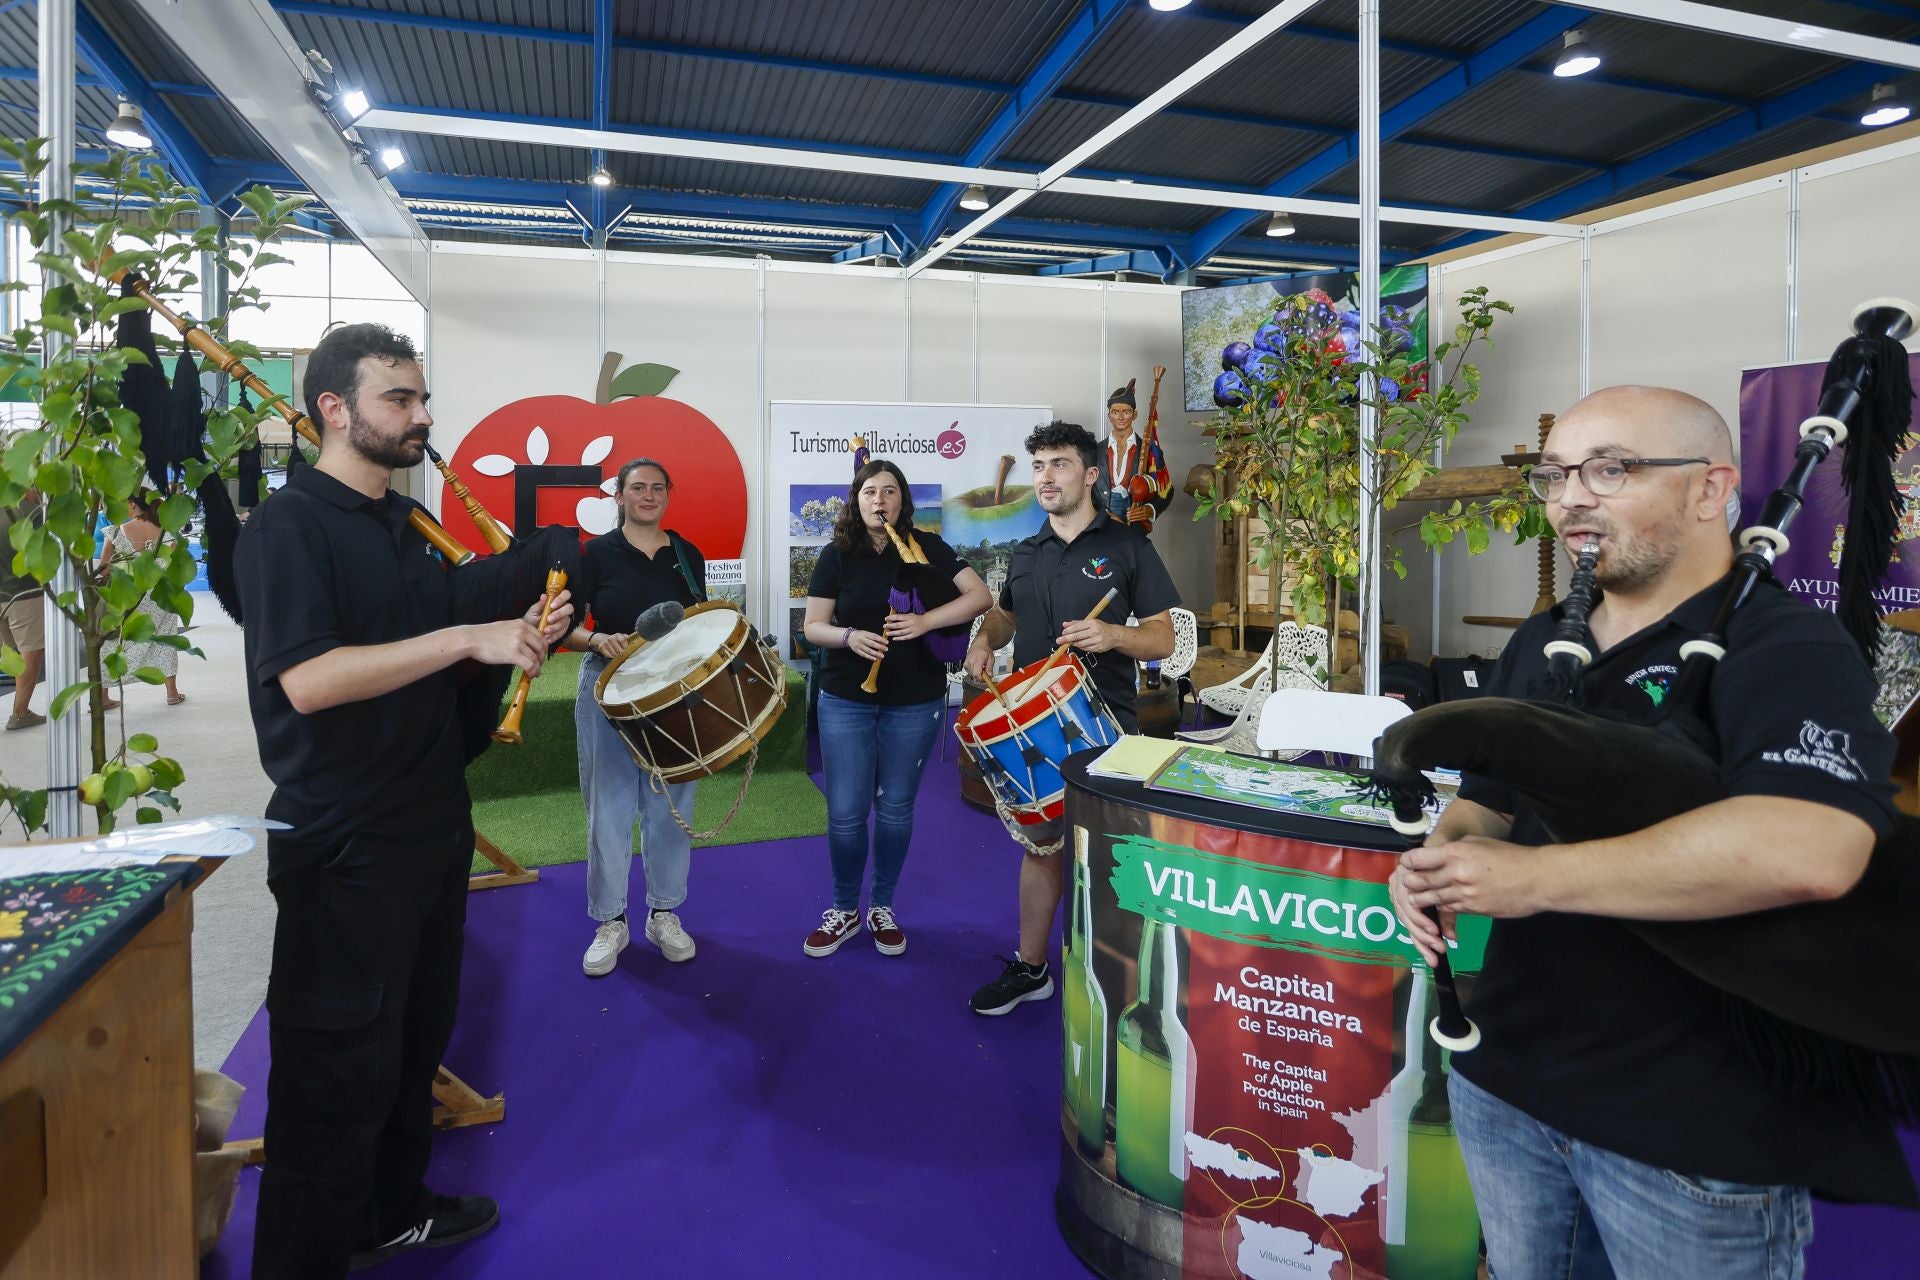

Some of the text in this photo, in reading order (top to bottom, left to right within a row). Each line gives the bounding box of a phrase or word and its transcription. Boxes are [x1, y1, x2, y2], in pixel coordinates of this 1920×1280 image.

[790, 431, 849, 453] Turismo
[707, 562, 742, 571] Festival
[1239, 966, 1335, 1003] Capital
[1214, 982, 1363, 1033] Manzanera
[1238, 1016, 1334, 1048] de España
[1242, 1052, 1327, 1082] The Capital
[1242, 1080, 1326, 1111] Production
[1254, 1073, 1313, 1093] of Apple
[1257, 1099, 1308, 1120] in Spain
[1259, 1249, 1312, 1273] Villaviciosa
